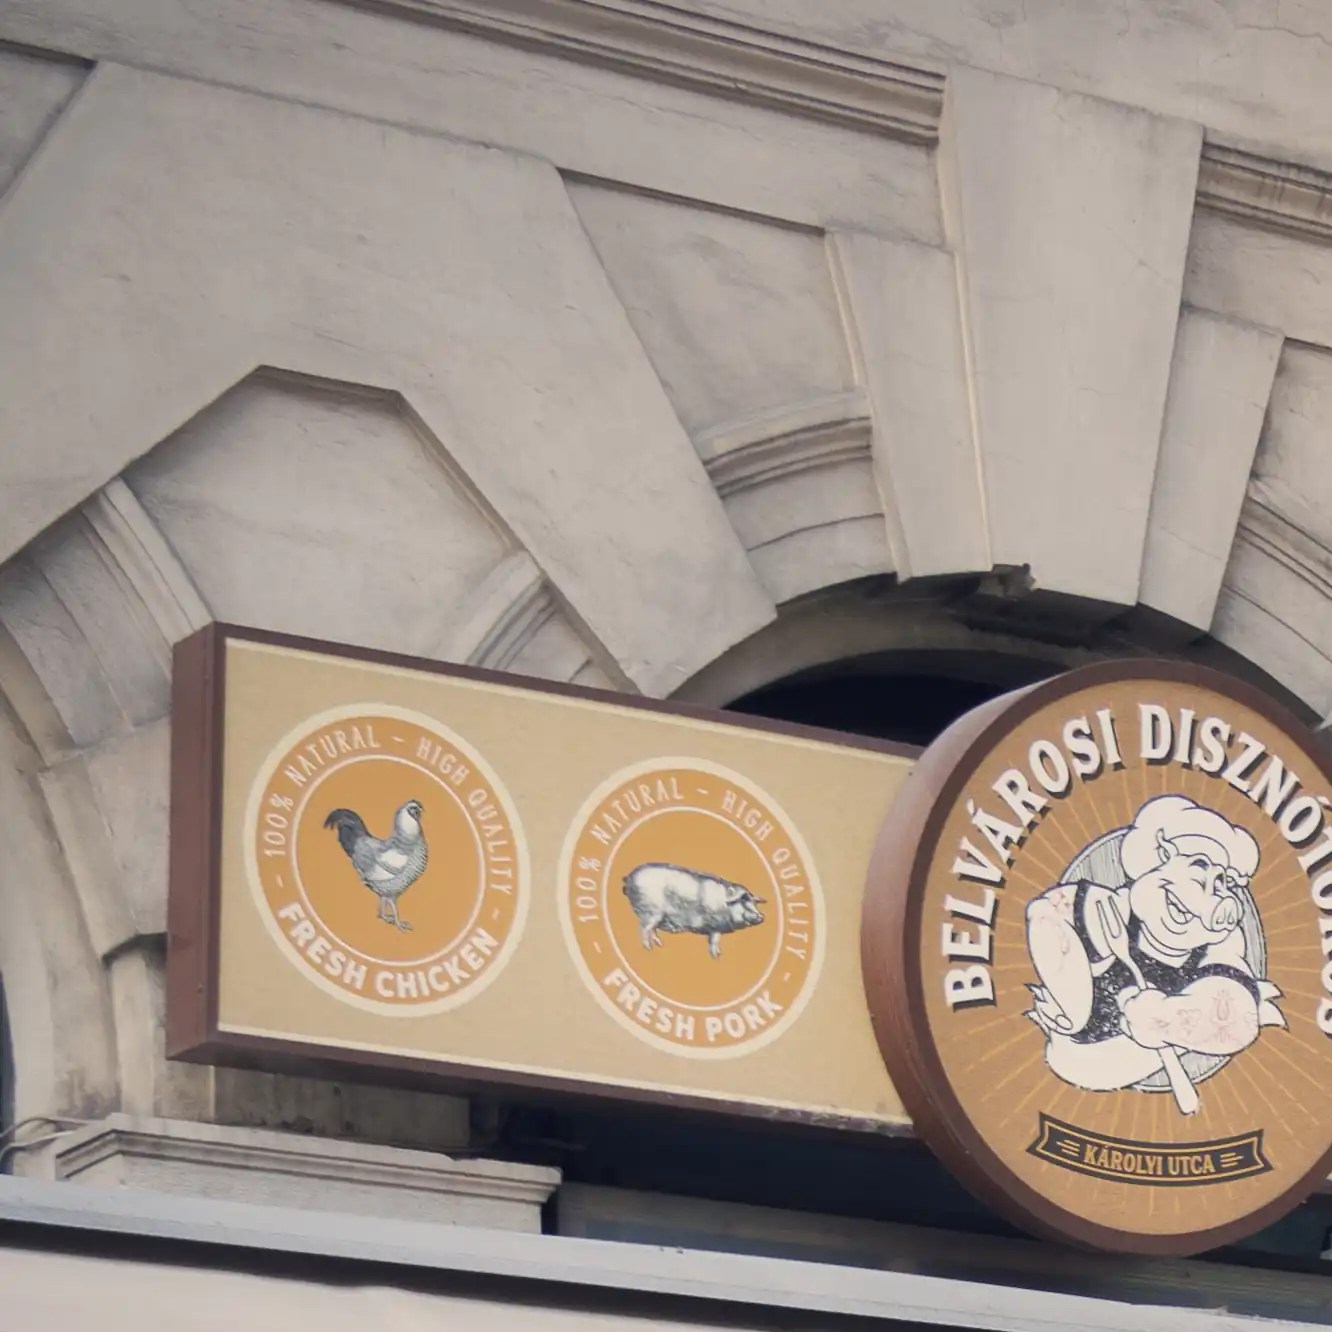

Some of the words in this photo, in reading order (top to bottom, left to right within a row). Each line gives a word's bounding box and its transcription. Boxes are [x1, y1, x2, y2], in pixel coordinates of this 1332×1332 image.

[263, 792, 294, 858] 100%
[284, 724, 382, 788] NATURAL
[417, 737, 470, 785] HIGH
[469, 789, 514, 895] QUALITY
[577, 857, 601, 922] 100%
[592, 777, 685, 844] NATURAL
[722, 790, 773, 843] HIGH
[772, 847, 808, 962] QUALITY
[940, 707, 1126, 1012] BELVÁROSI
[278, 903, 367, 989] FRESH
[374, 928, 500, 998] CHICKEN
[602, 968, 696, 1041] FRESH
[704, 990, 784, 1042] PORK
[1083, 1143, 1164, 1176] KÁROLYI
[1167, 1153, 1216, 1176] UTCA
